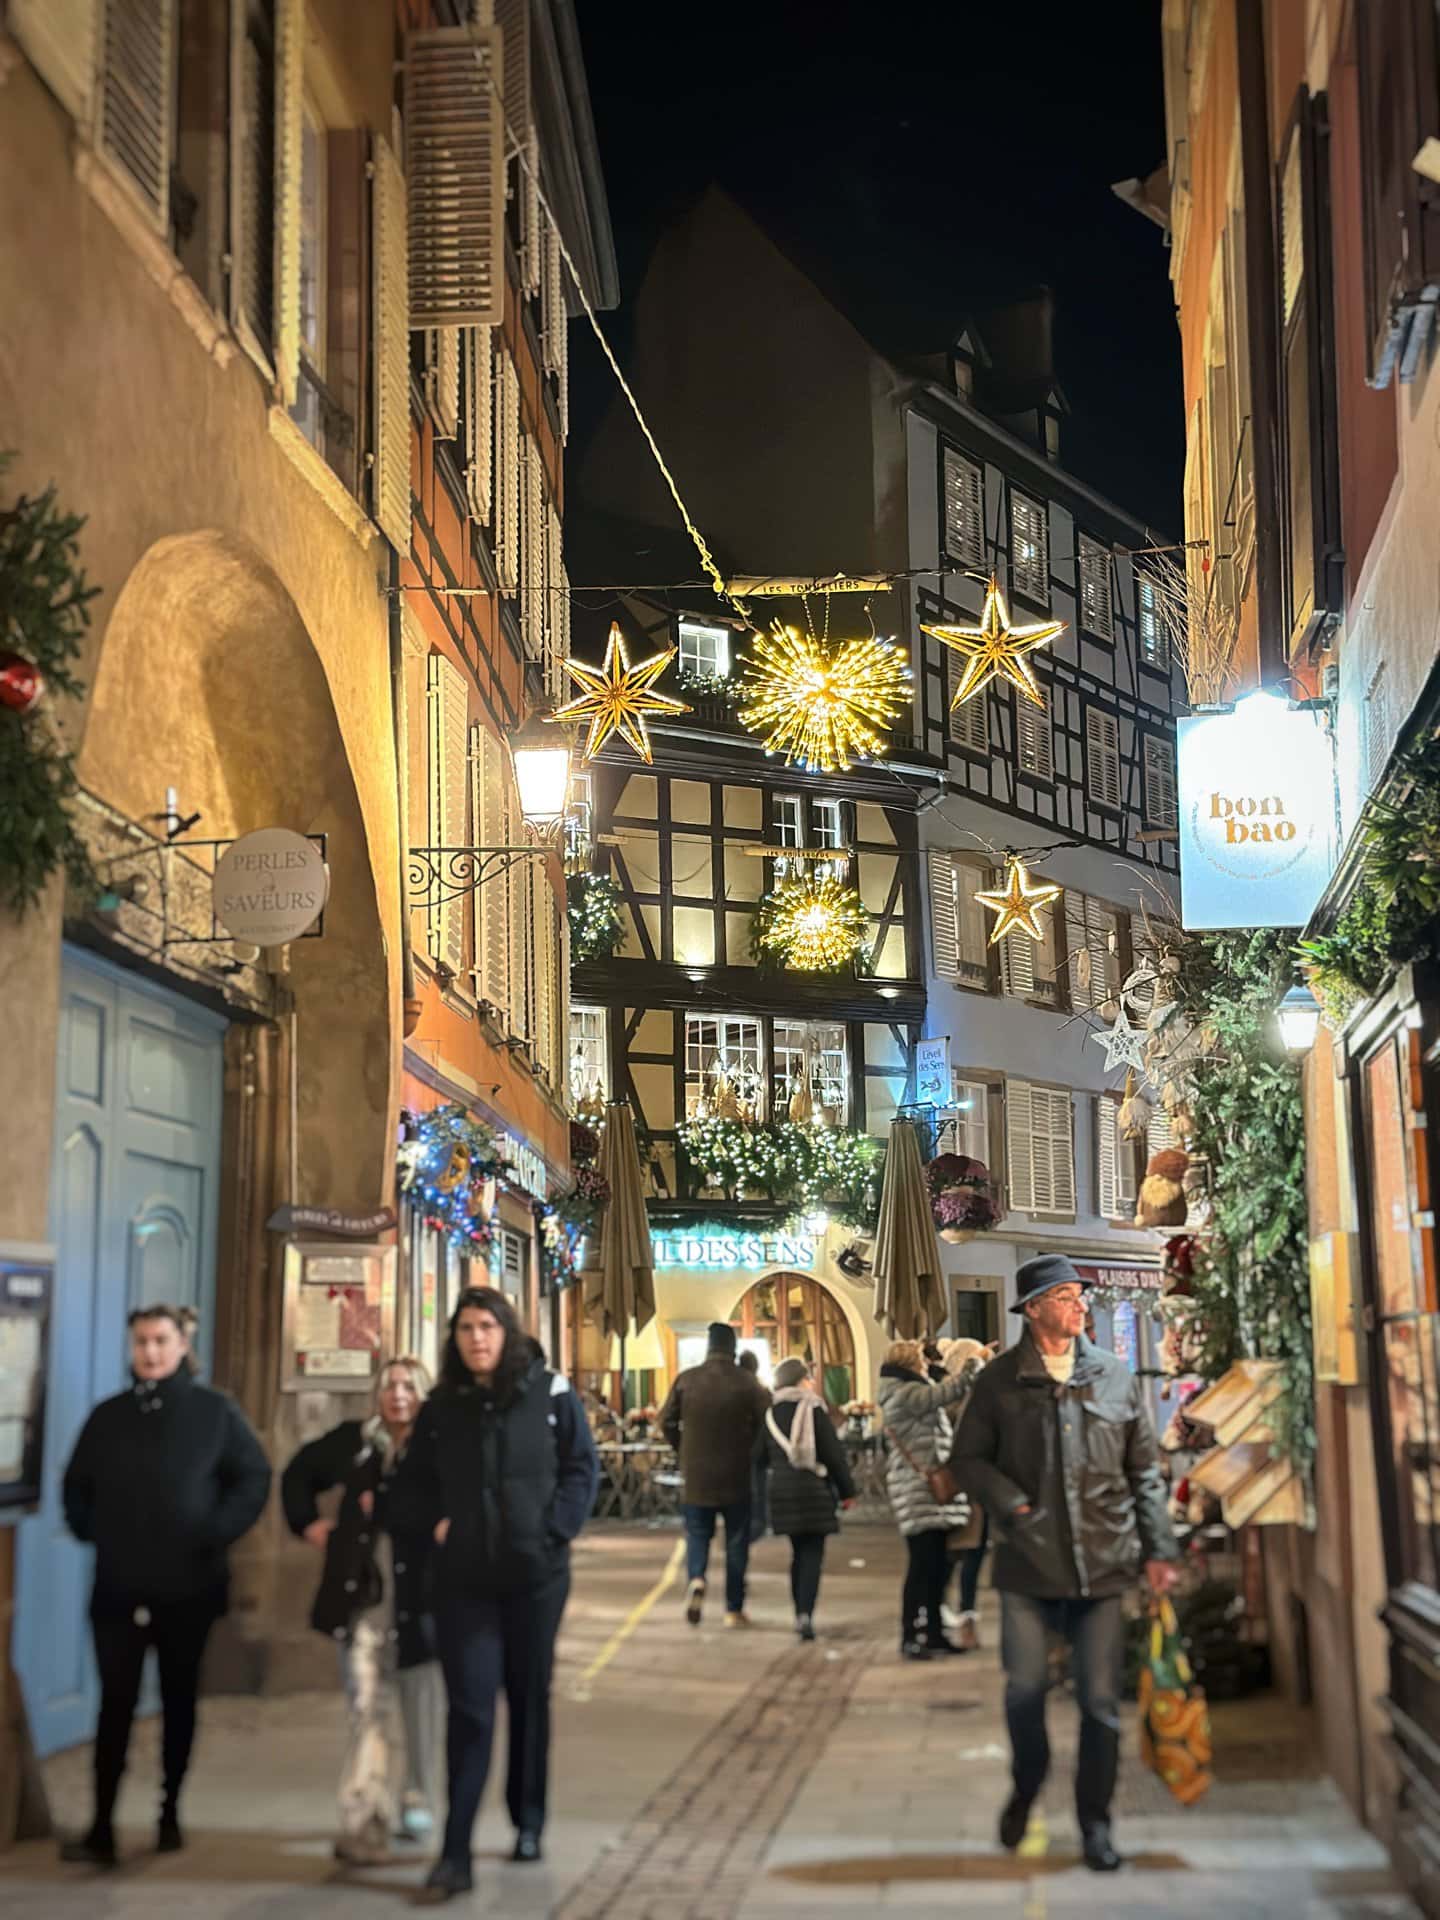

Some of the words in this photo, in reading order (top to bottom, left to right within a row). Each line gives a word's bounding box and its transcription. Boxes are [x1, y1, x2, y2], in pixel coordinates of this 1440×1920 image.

[1209, 792, 1285, 818] bon
[1225, 817, 1296, 844] bao
[232, 850, 308, 872] PERLES
[223, 891, 316, 913] SAVEURS
[684, 1239, 738, 1263] DES
[742, 1239, 814, 1264] SENS
[1097, 1269, 1138, 1286] PLAISIRS
